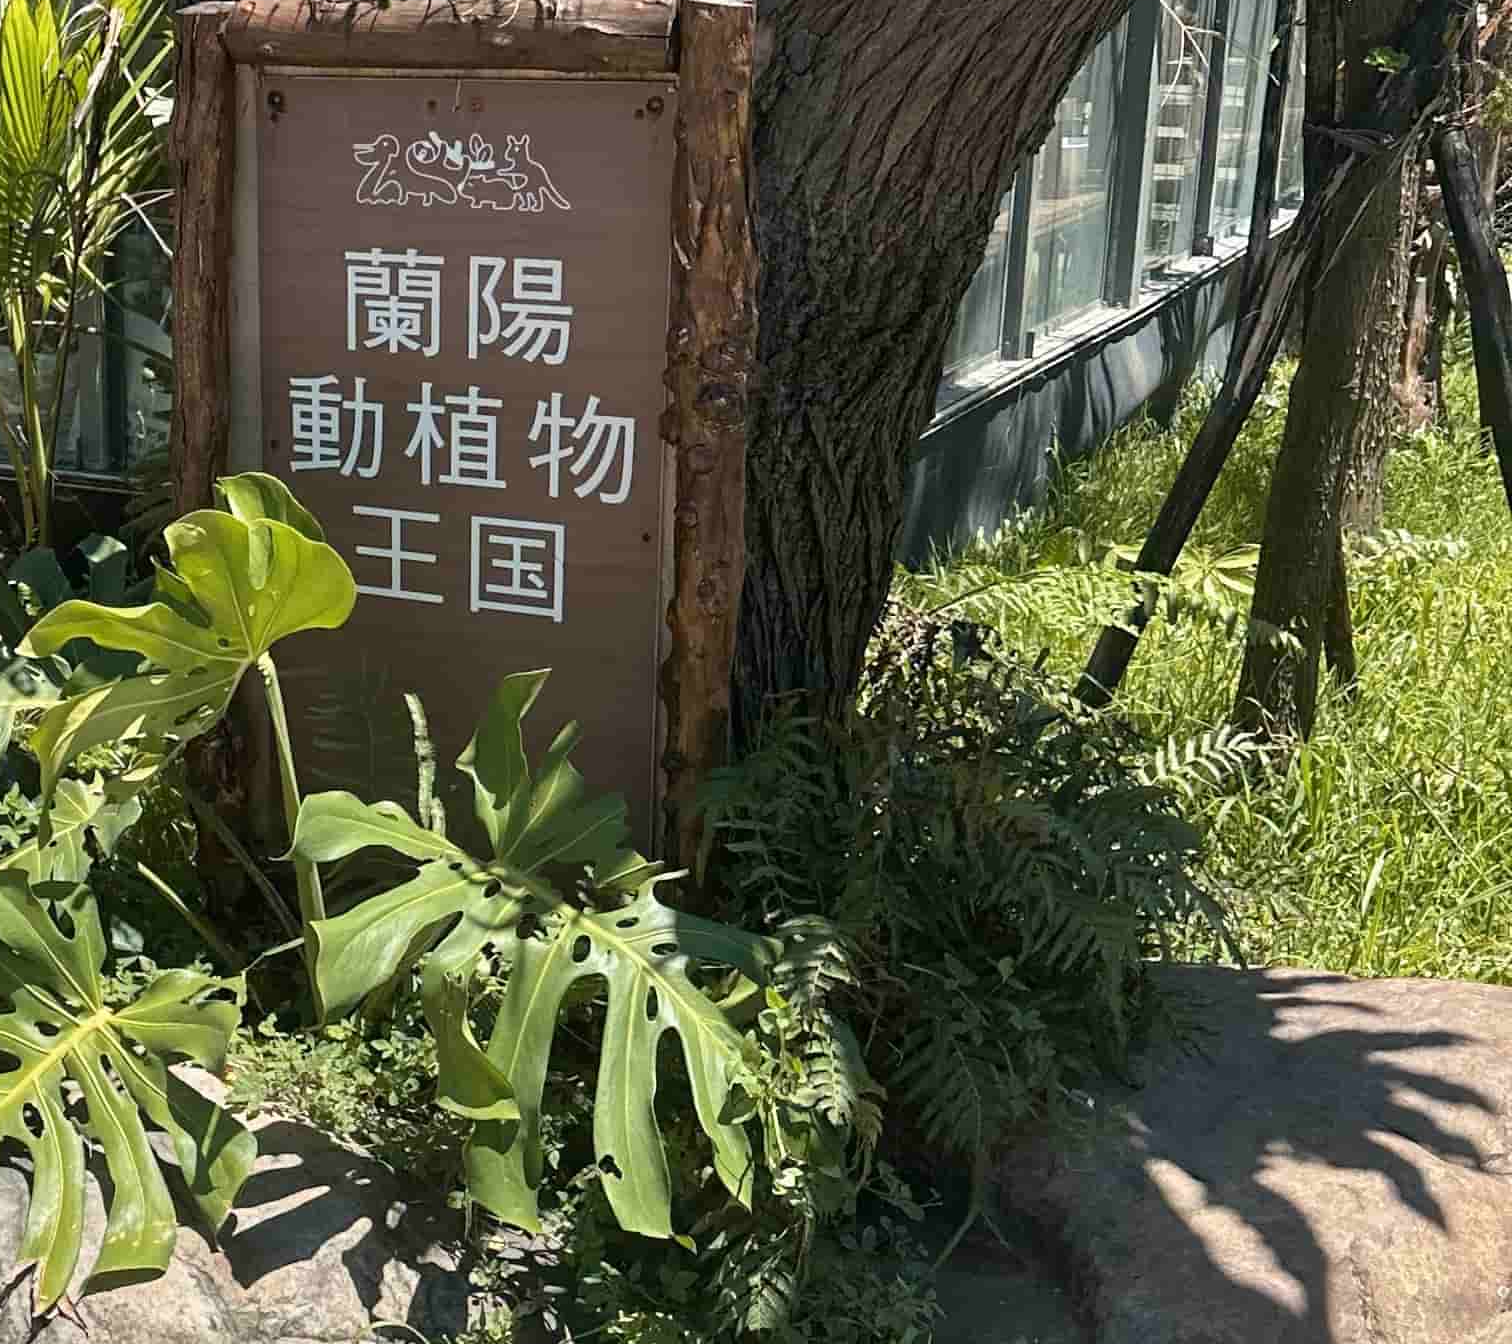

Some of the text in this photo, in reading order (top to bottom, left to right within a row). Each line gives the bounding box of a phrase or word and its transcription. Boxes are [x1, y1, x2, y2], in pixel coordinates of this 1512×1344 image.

[344, 248, 574, 366] 蘭陽
[289, 374, 636, 505] 動植物
[352, 504, 567, 624] 王国
